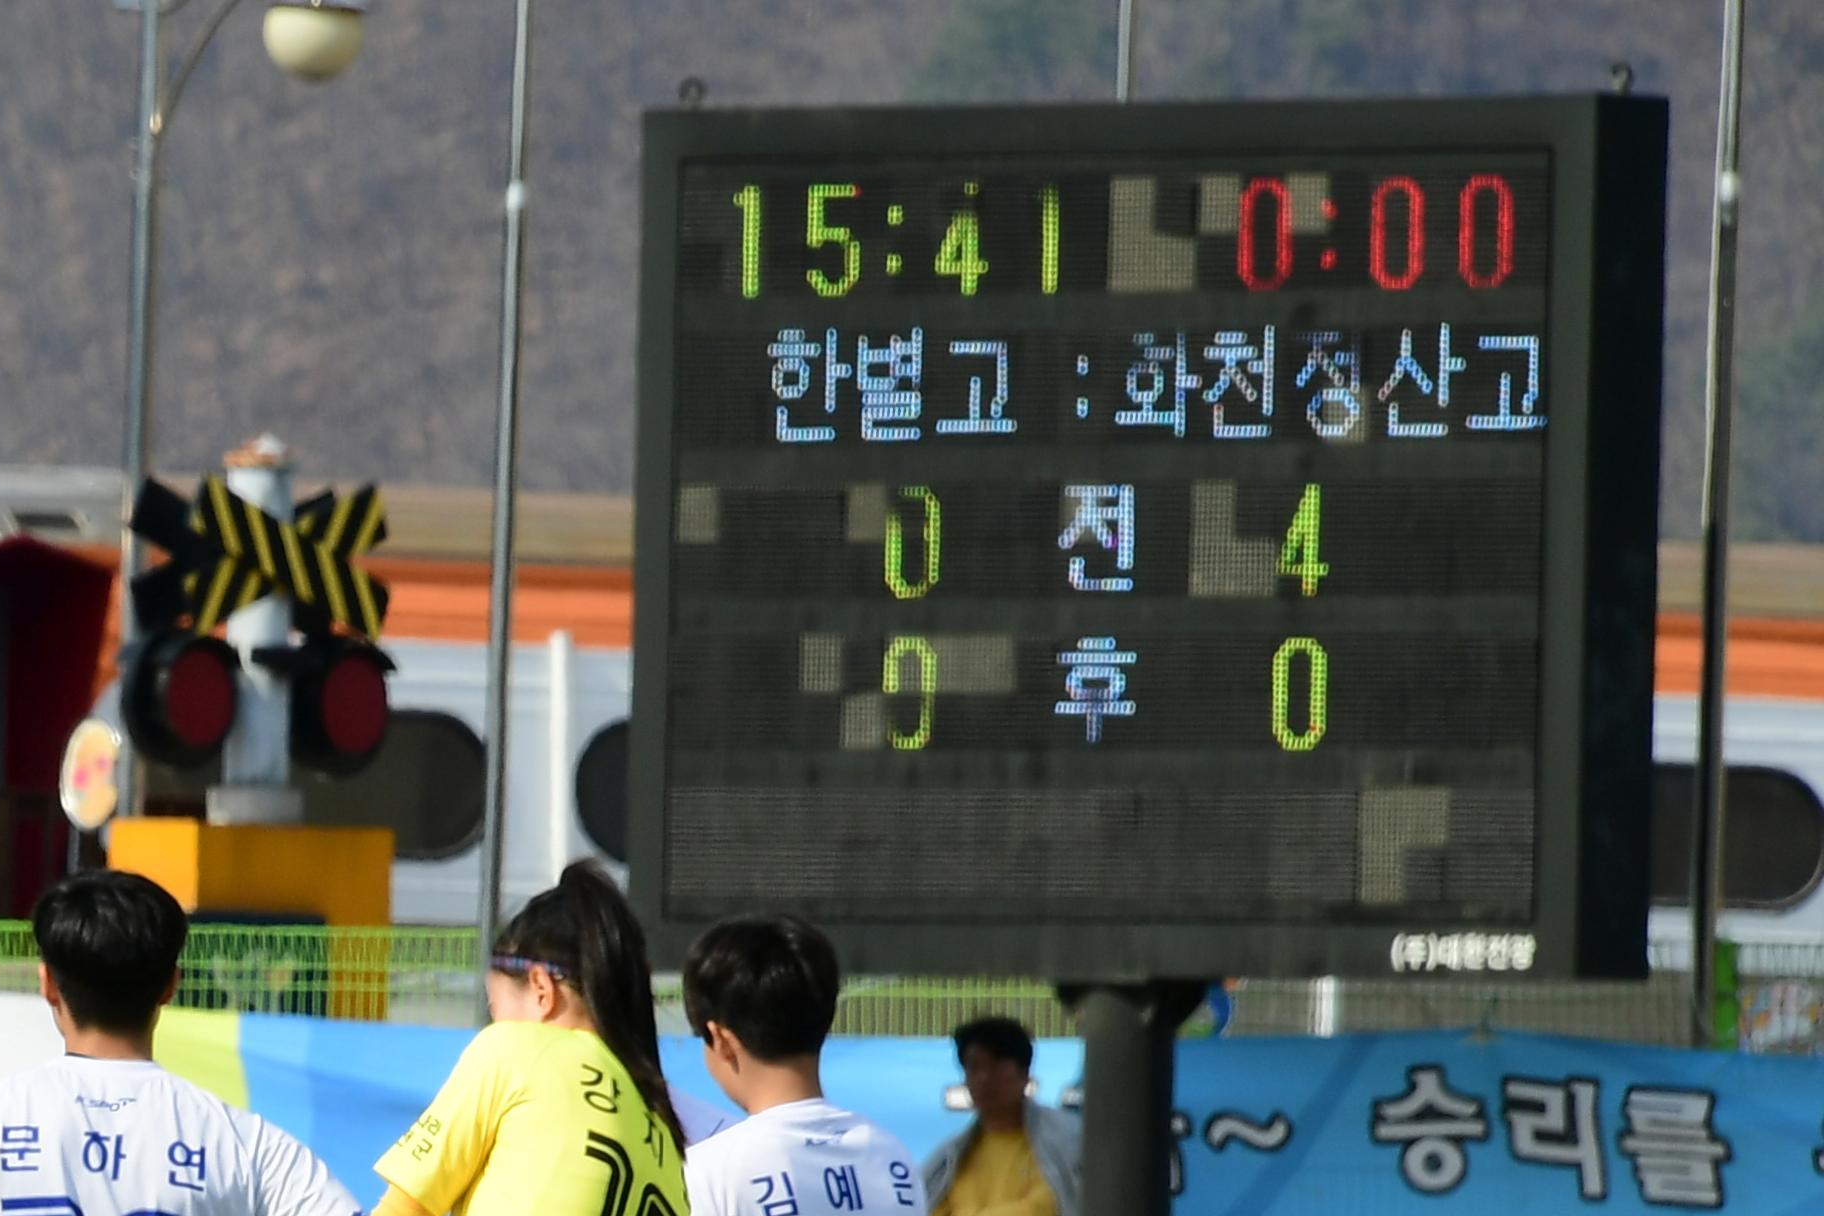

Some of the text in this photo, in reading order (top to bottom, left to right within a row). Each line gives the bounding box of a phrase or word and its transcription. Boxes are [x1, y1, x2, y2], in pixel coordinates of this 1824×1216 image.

[733, 178, 1059, 298] 15:41
[1237, 174, 1514, 292] 0:00
[767, 326, 1018, 442] 한별고
[1116, 321, 1548, 438] 화천정산고
[884, 488, 939, 599] 0
[1060, 484, 1134, 592] 전
[1277, 484, 1330, 598] 4
[1054, 636, 1137, 744] 후
[1271, 636, 1328, 751] 0
[1374, 1063, 1732, 1208] 승리를
